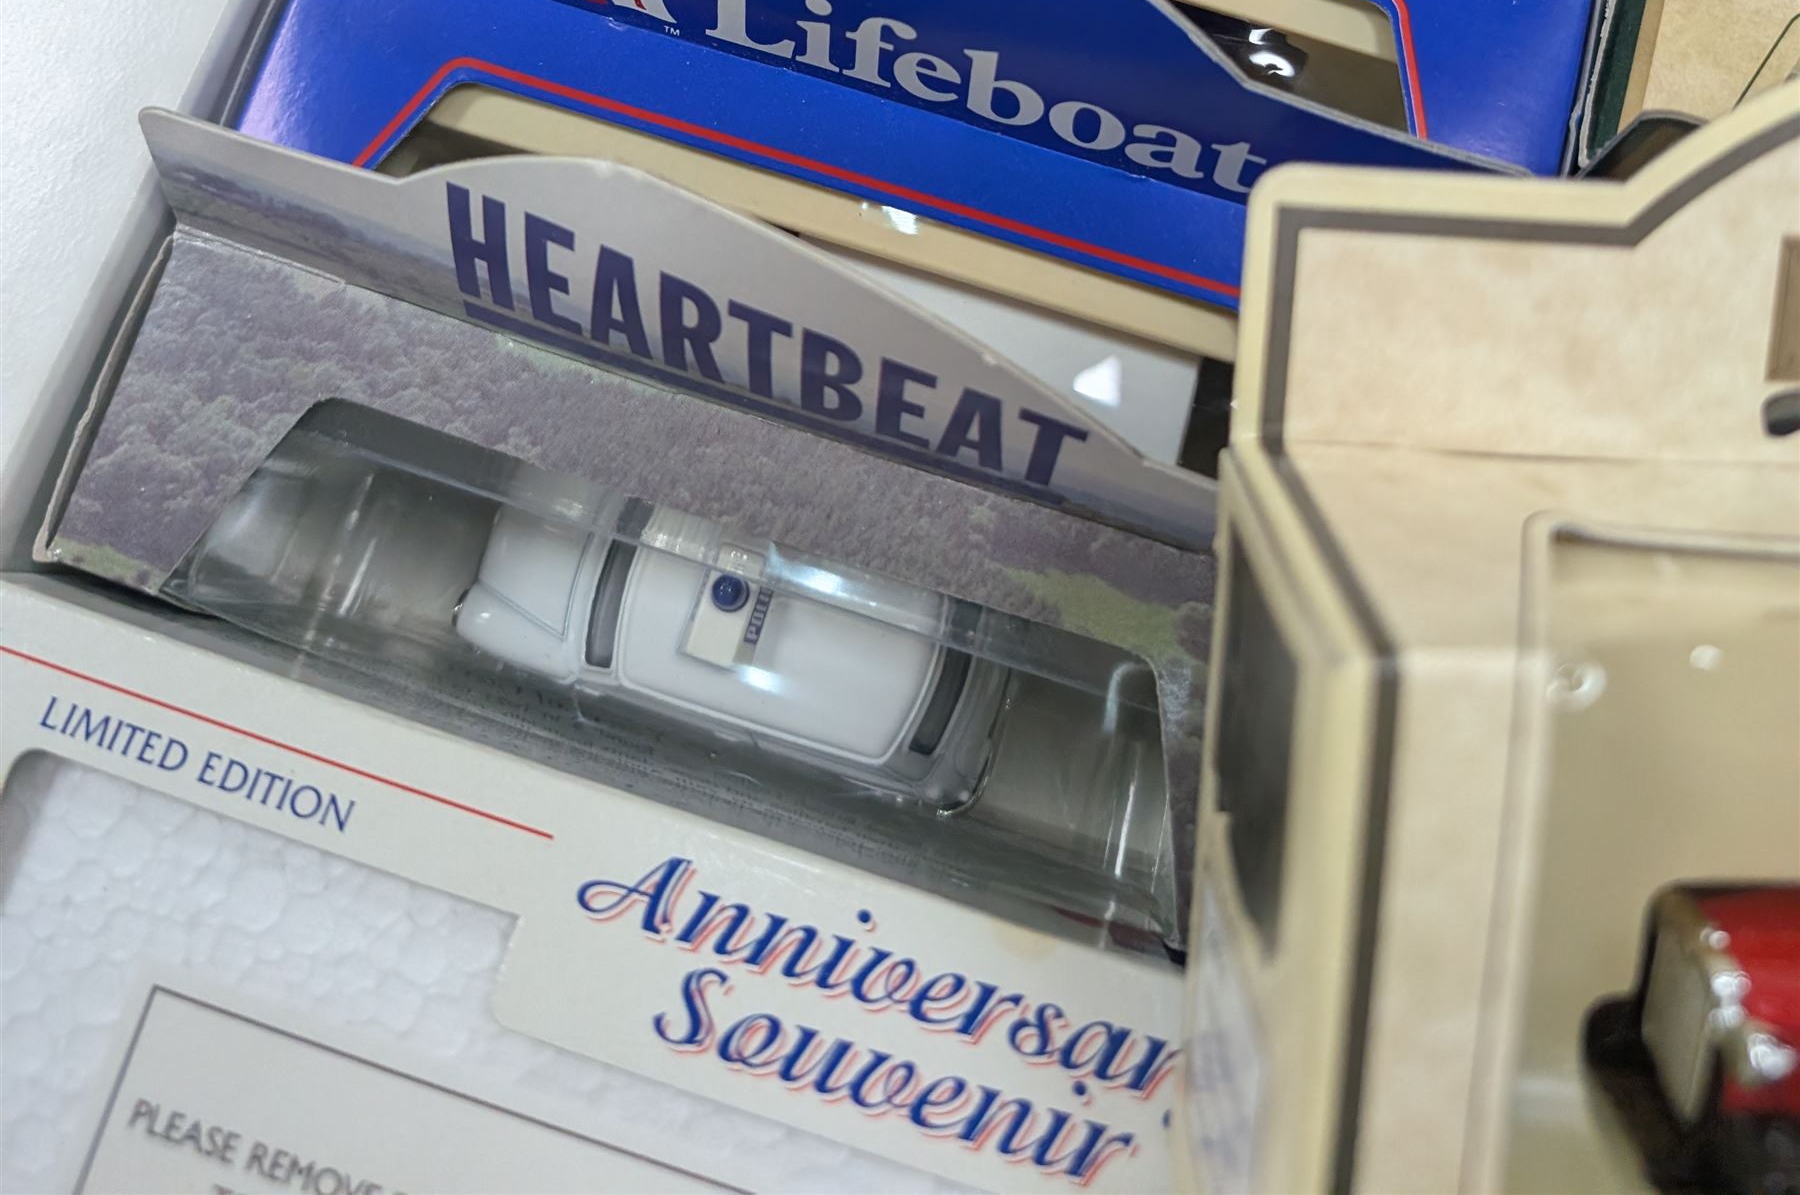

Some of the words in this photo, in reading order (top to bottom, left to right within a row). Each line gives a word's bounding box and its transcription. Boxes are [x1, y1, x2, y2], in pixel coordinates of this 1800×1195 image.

[446, 181, 1089, 487] HEARTBEAT
[38, 696, 190, 774] LIMITED
[196, 752, 357, 833] EDITION
[575, 856, 1184, 1130] Anniversar
[652, 966, 1139, 1188] Souvenir
[128, 1098, 242, 1165] PLEASE
